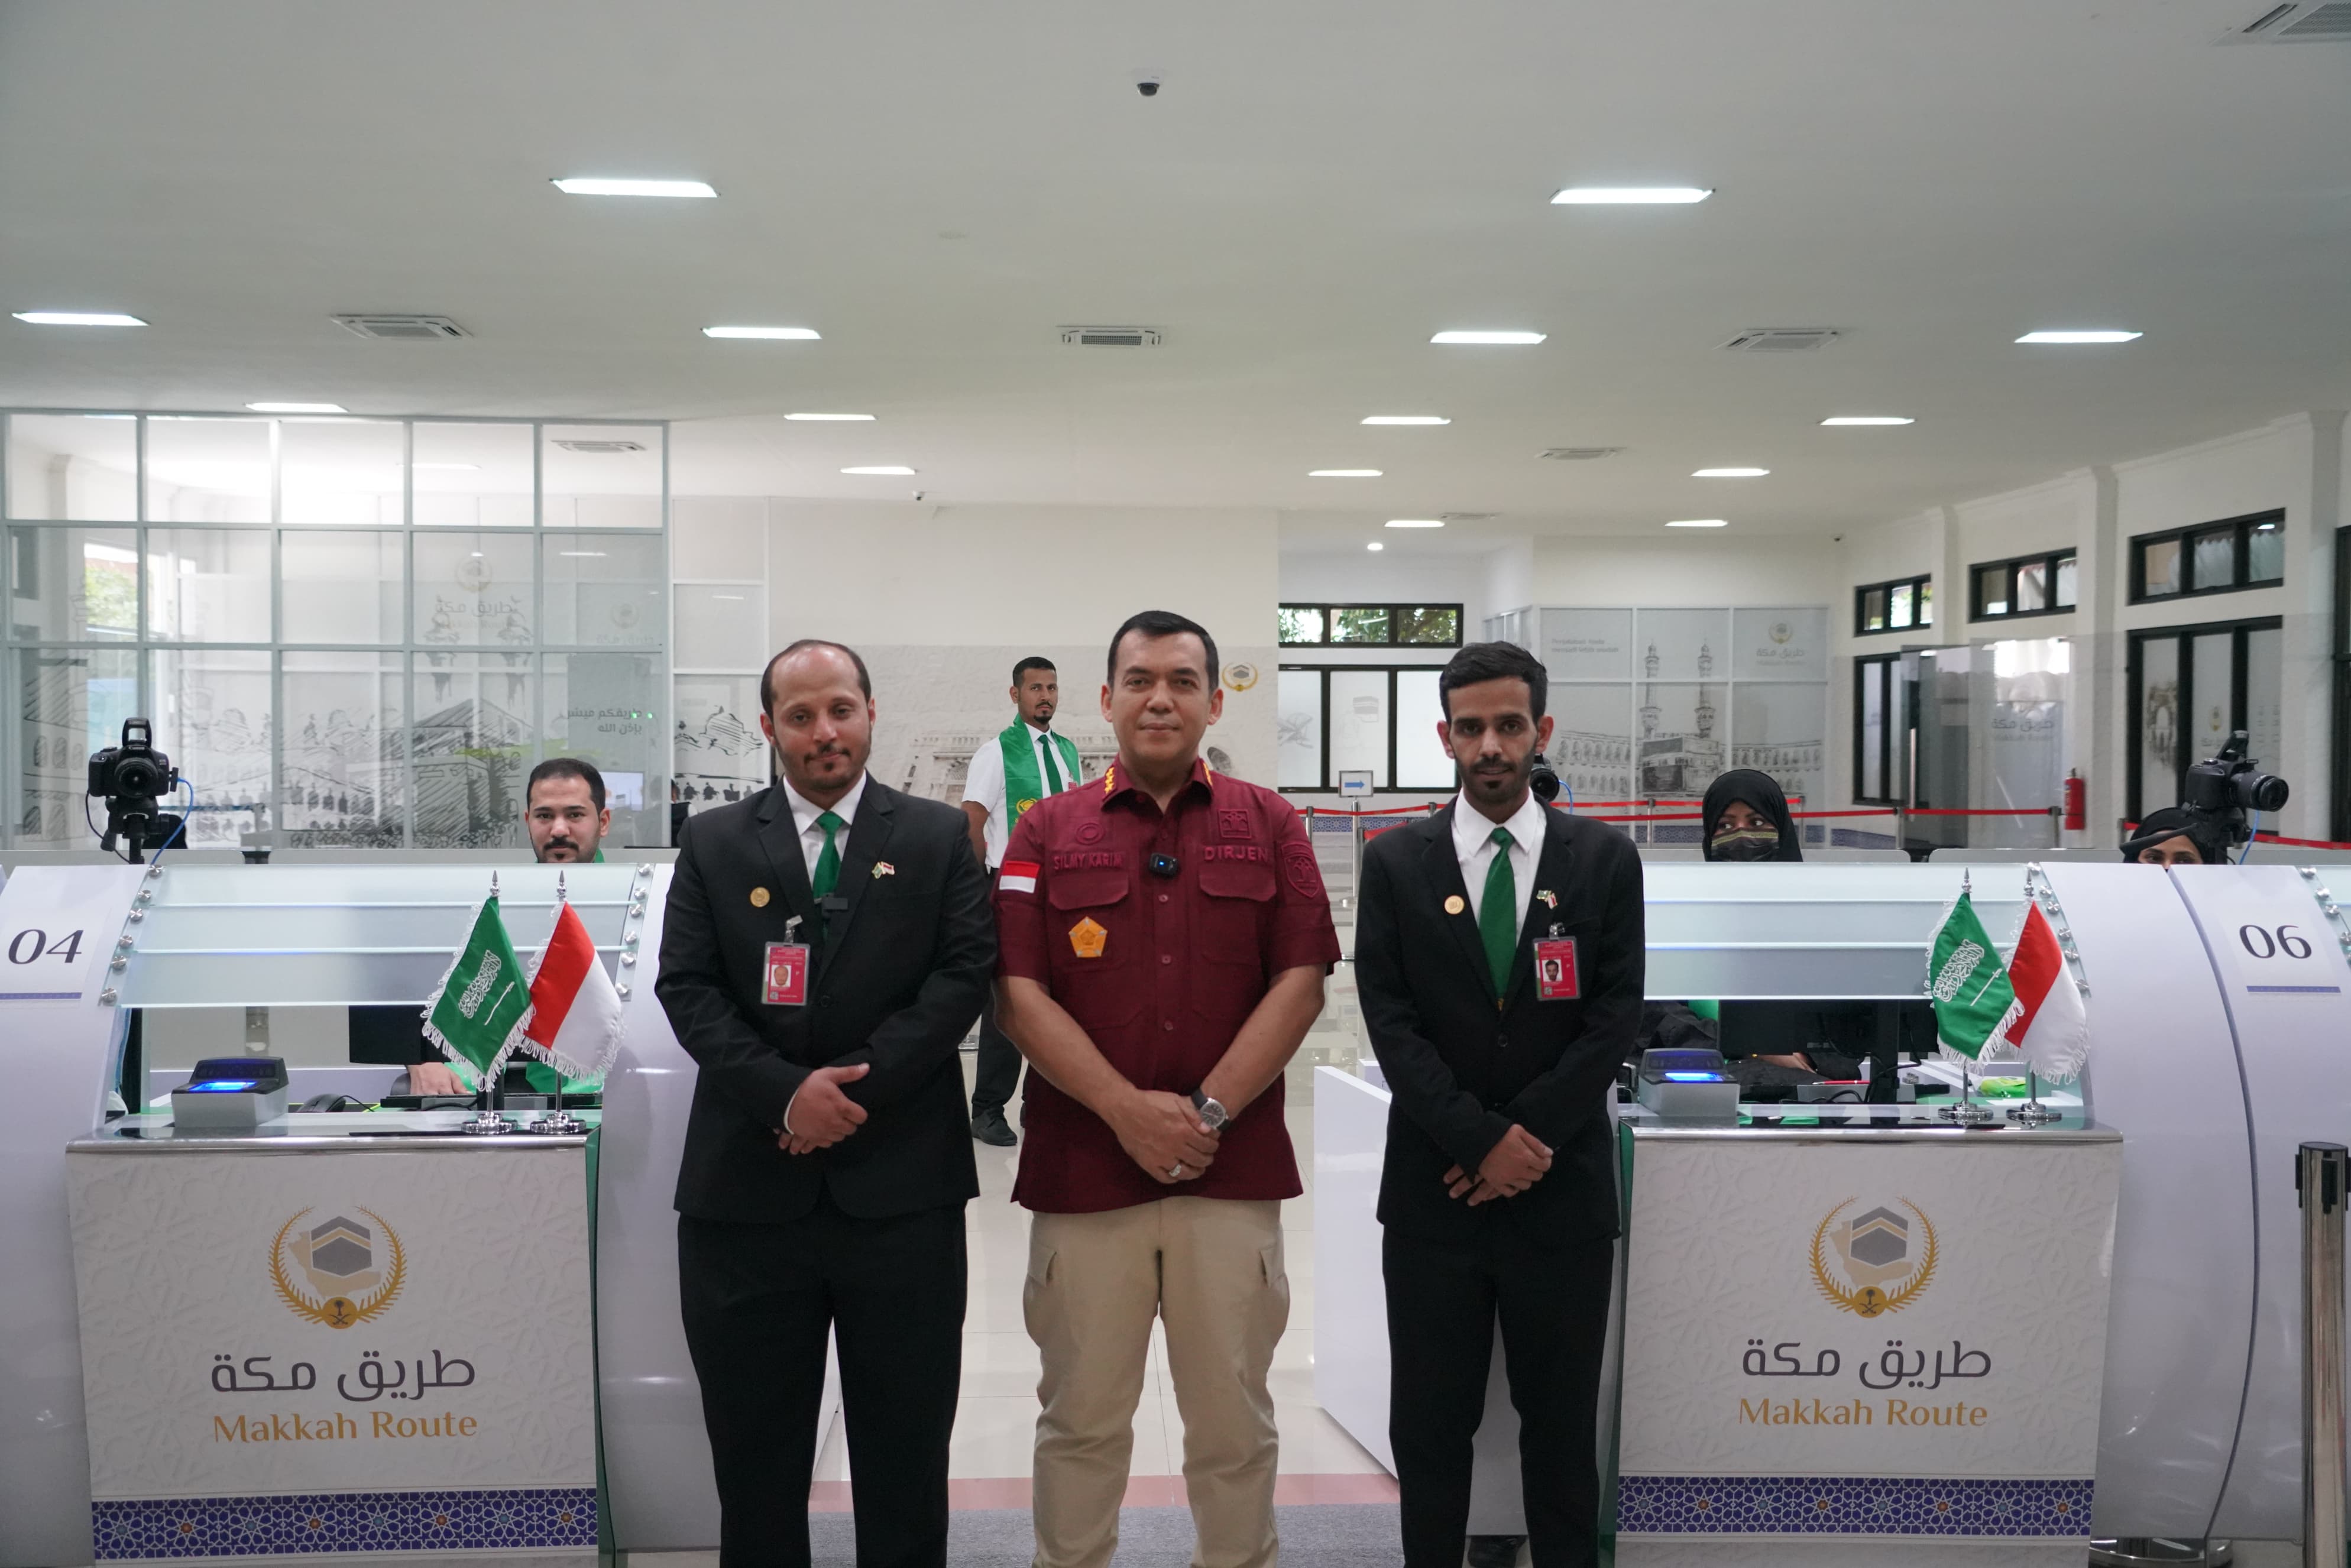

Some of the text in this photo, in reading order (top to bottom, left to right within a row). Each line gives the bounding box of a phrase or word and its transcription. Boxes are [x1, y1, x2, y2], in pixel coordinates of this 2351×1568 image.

[597, 723, 616, 732] الله
[1054, 853, 1122, 870] SILMY KARIM
[1204, 845, 1269, 861] DIRJEN
[8, 929, 83, 964] 04
[2239, 925, 2312, 959] 06
[212, 1349, 475, 1402] طريق مكة
[1743, 1339, 1991, 1389] طريق مكة
[213, 1411, 478, 1443] Makkah Route
[1739, 1398, 1988, 1427] Makkah Route
